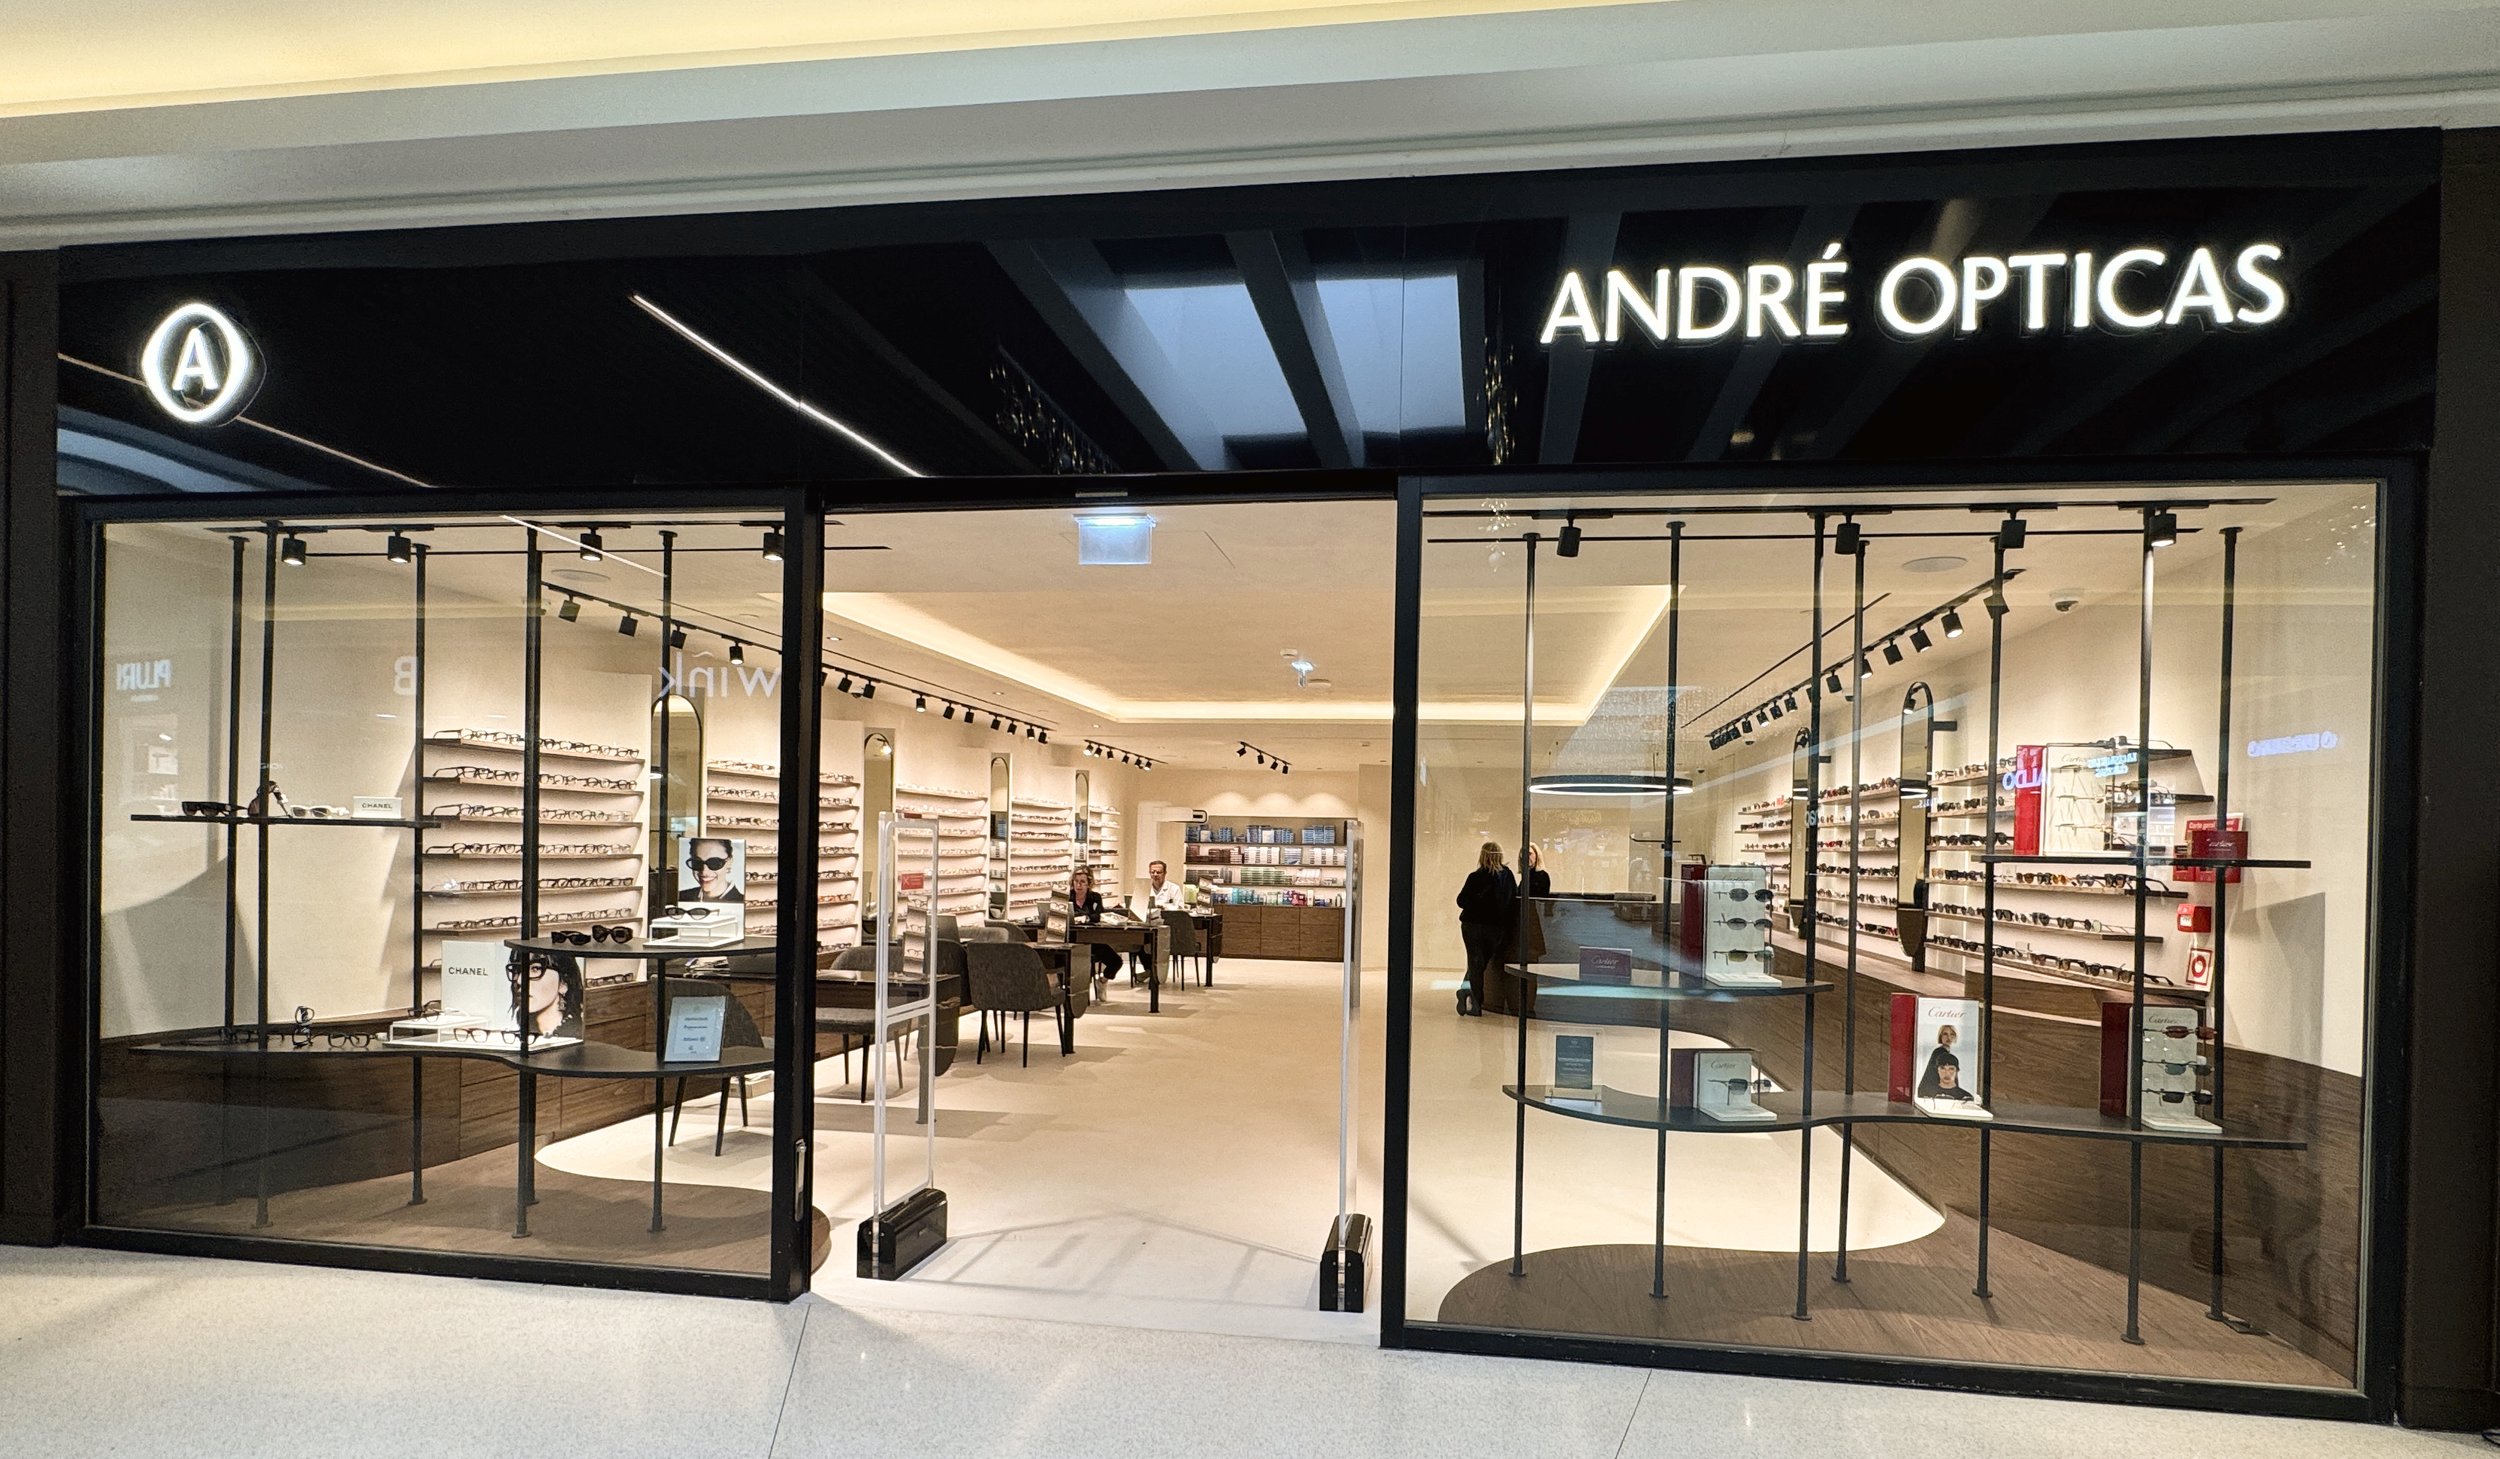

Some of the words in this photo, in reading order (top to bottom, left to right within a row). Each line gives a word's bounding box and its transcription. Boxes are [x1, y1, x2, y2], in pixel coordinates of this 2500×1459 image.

[1540, 243, 1848, 344] ANDRÉ
[1879, 243, 2286, 335] OPTICAS
[448, 966, 489, 976] CHANEL
[1928, 1006, 1967, 1018] Cartier
[1710, 1060, 1737, 1070] Cartier
